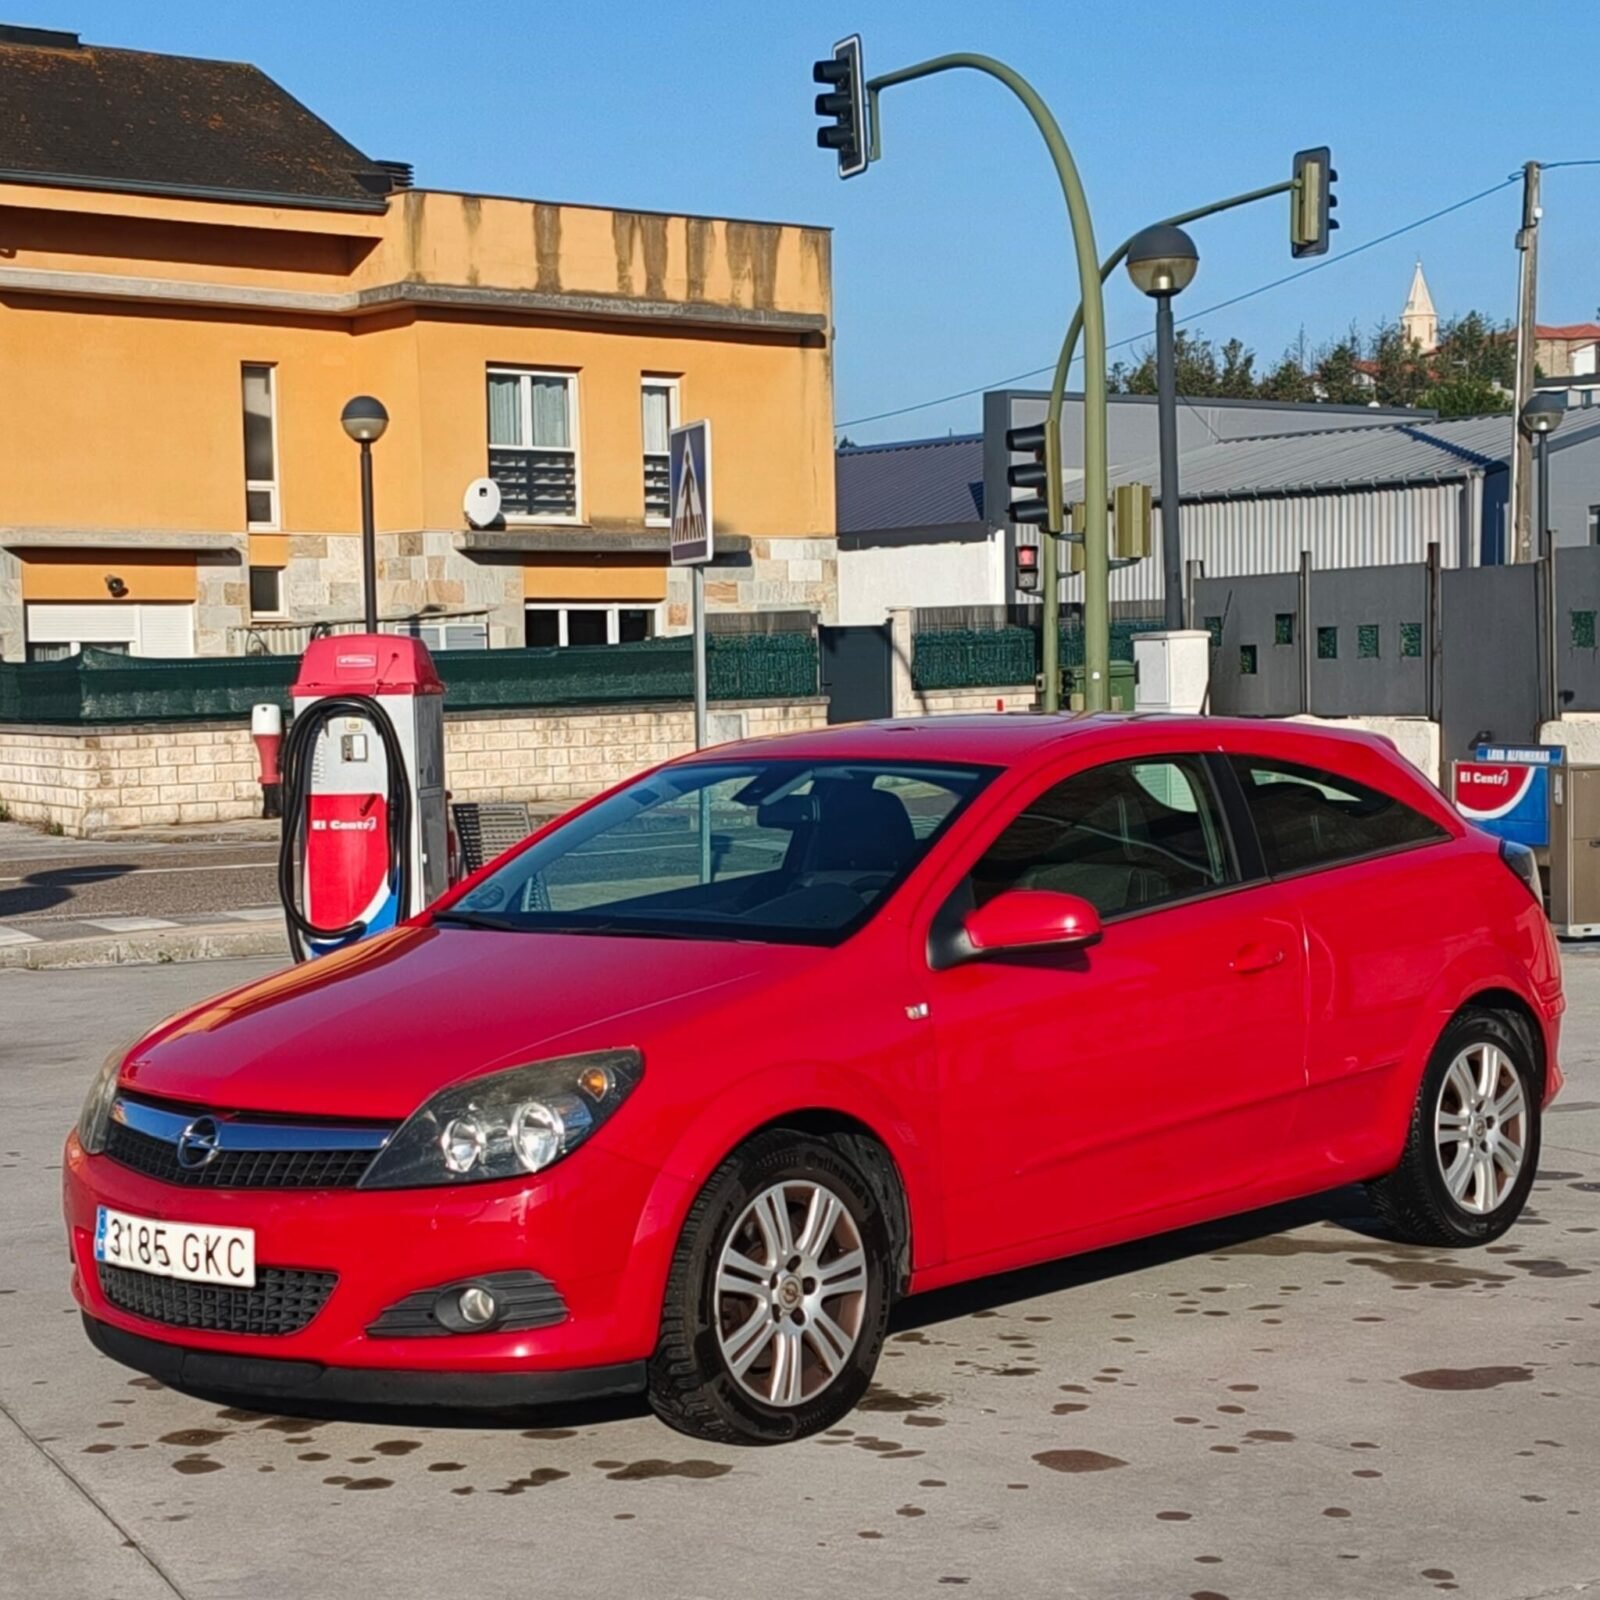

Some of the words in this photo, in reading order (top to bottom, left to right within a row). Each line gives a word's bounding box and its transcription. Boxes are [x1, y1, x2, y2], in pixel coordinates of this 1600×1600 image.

[1460, 771, 1471, 783] El
[312, 819, 327, 831] El
[110, 1218, 171, 1267] 3185
[183, 1233, 245, 1278] GKC
